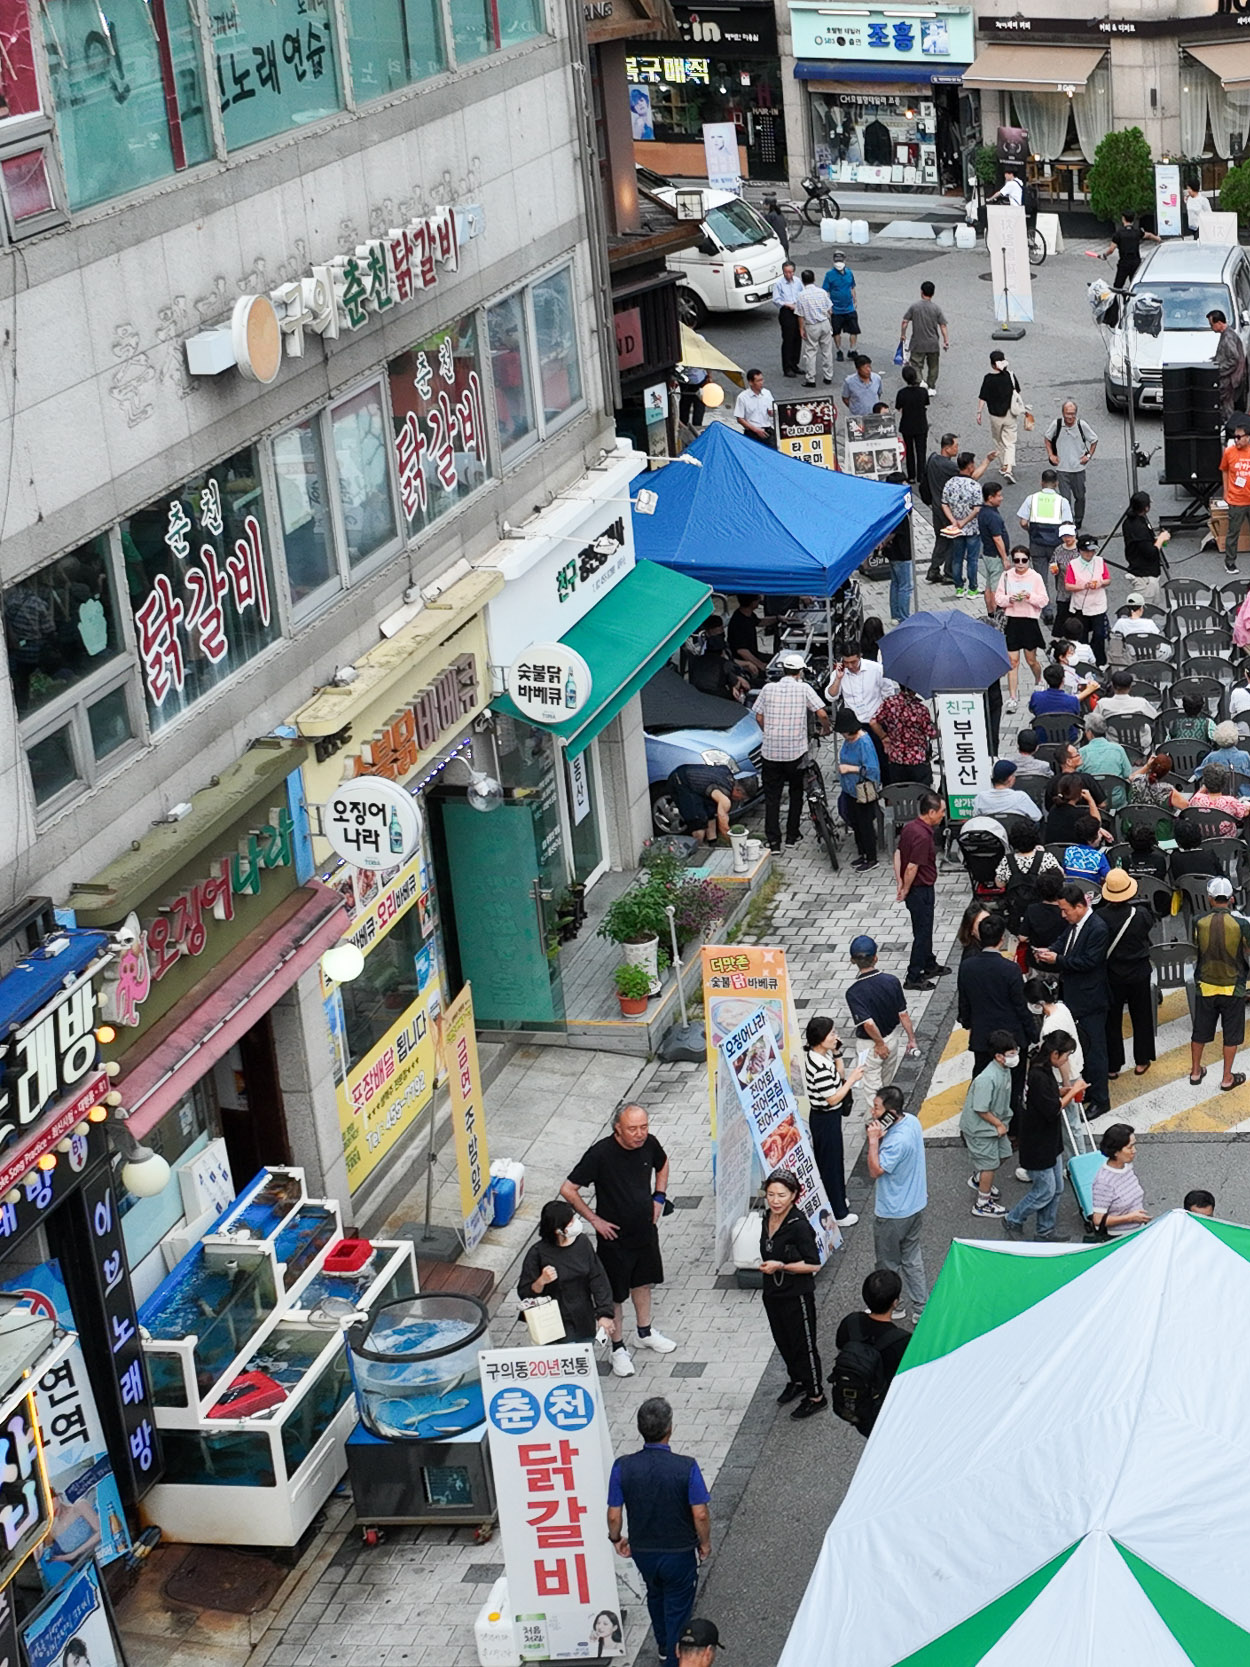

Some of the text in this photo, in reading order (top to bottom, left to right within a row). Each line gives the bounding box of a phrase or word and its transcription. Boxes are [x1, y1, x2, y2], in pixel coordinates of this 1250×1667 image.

[867, 21, 915, 52] 조흥
[415, 336, 455, 400] 춘천
[395, 371, 487, 521] 닭갈비
[164, 479, 224, 560] 춘천
[556, 559, 578, 603] 친구
[136, 514, 271, 707] 닭갈비
[517, 662, 563, 685] 숯불닭
[517, 684, 563, 706] 바베큐
[946, 700, 976, 715] 친구
[953, 720, 979, 786] 부동산
[333, 800, 388, 827] 오징어
[343, 827, 380, 853] 나라
[147, 807, 295, 981] 오징어나라
[710, 953, 751, 973] 더맛존
[725, 1011, 766, 1059] 오징어나라
[351, 1046, 396, 1116] 포장배달
[396, 1009, 427, 1064] 됩니다
[748, 1067, 775, 1100] 전어회
[750, 1079, 784, 1119] 전어무침
[755, 1095, 789, 1135] 전어구이
[493, 1386, 592, 1431] 춘천
[517, 1438, 591, 1605] 닭갈비
